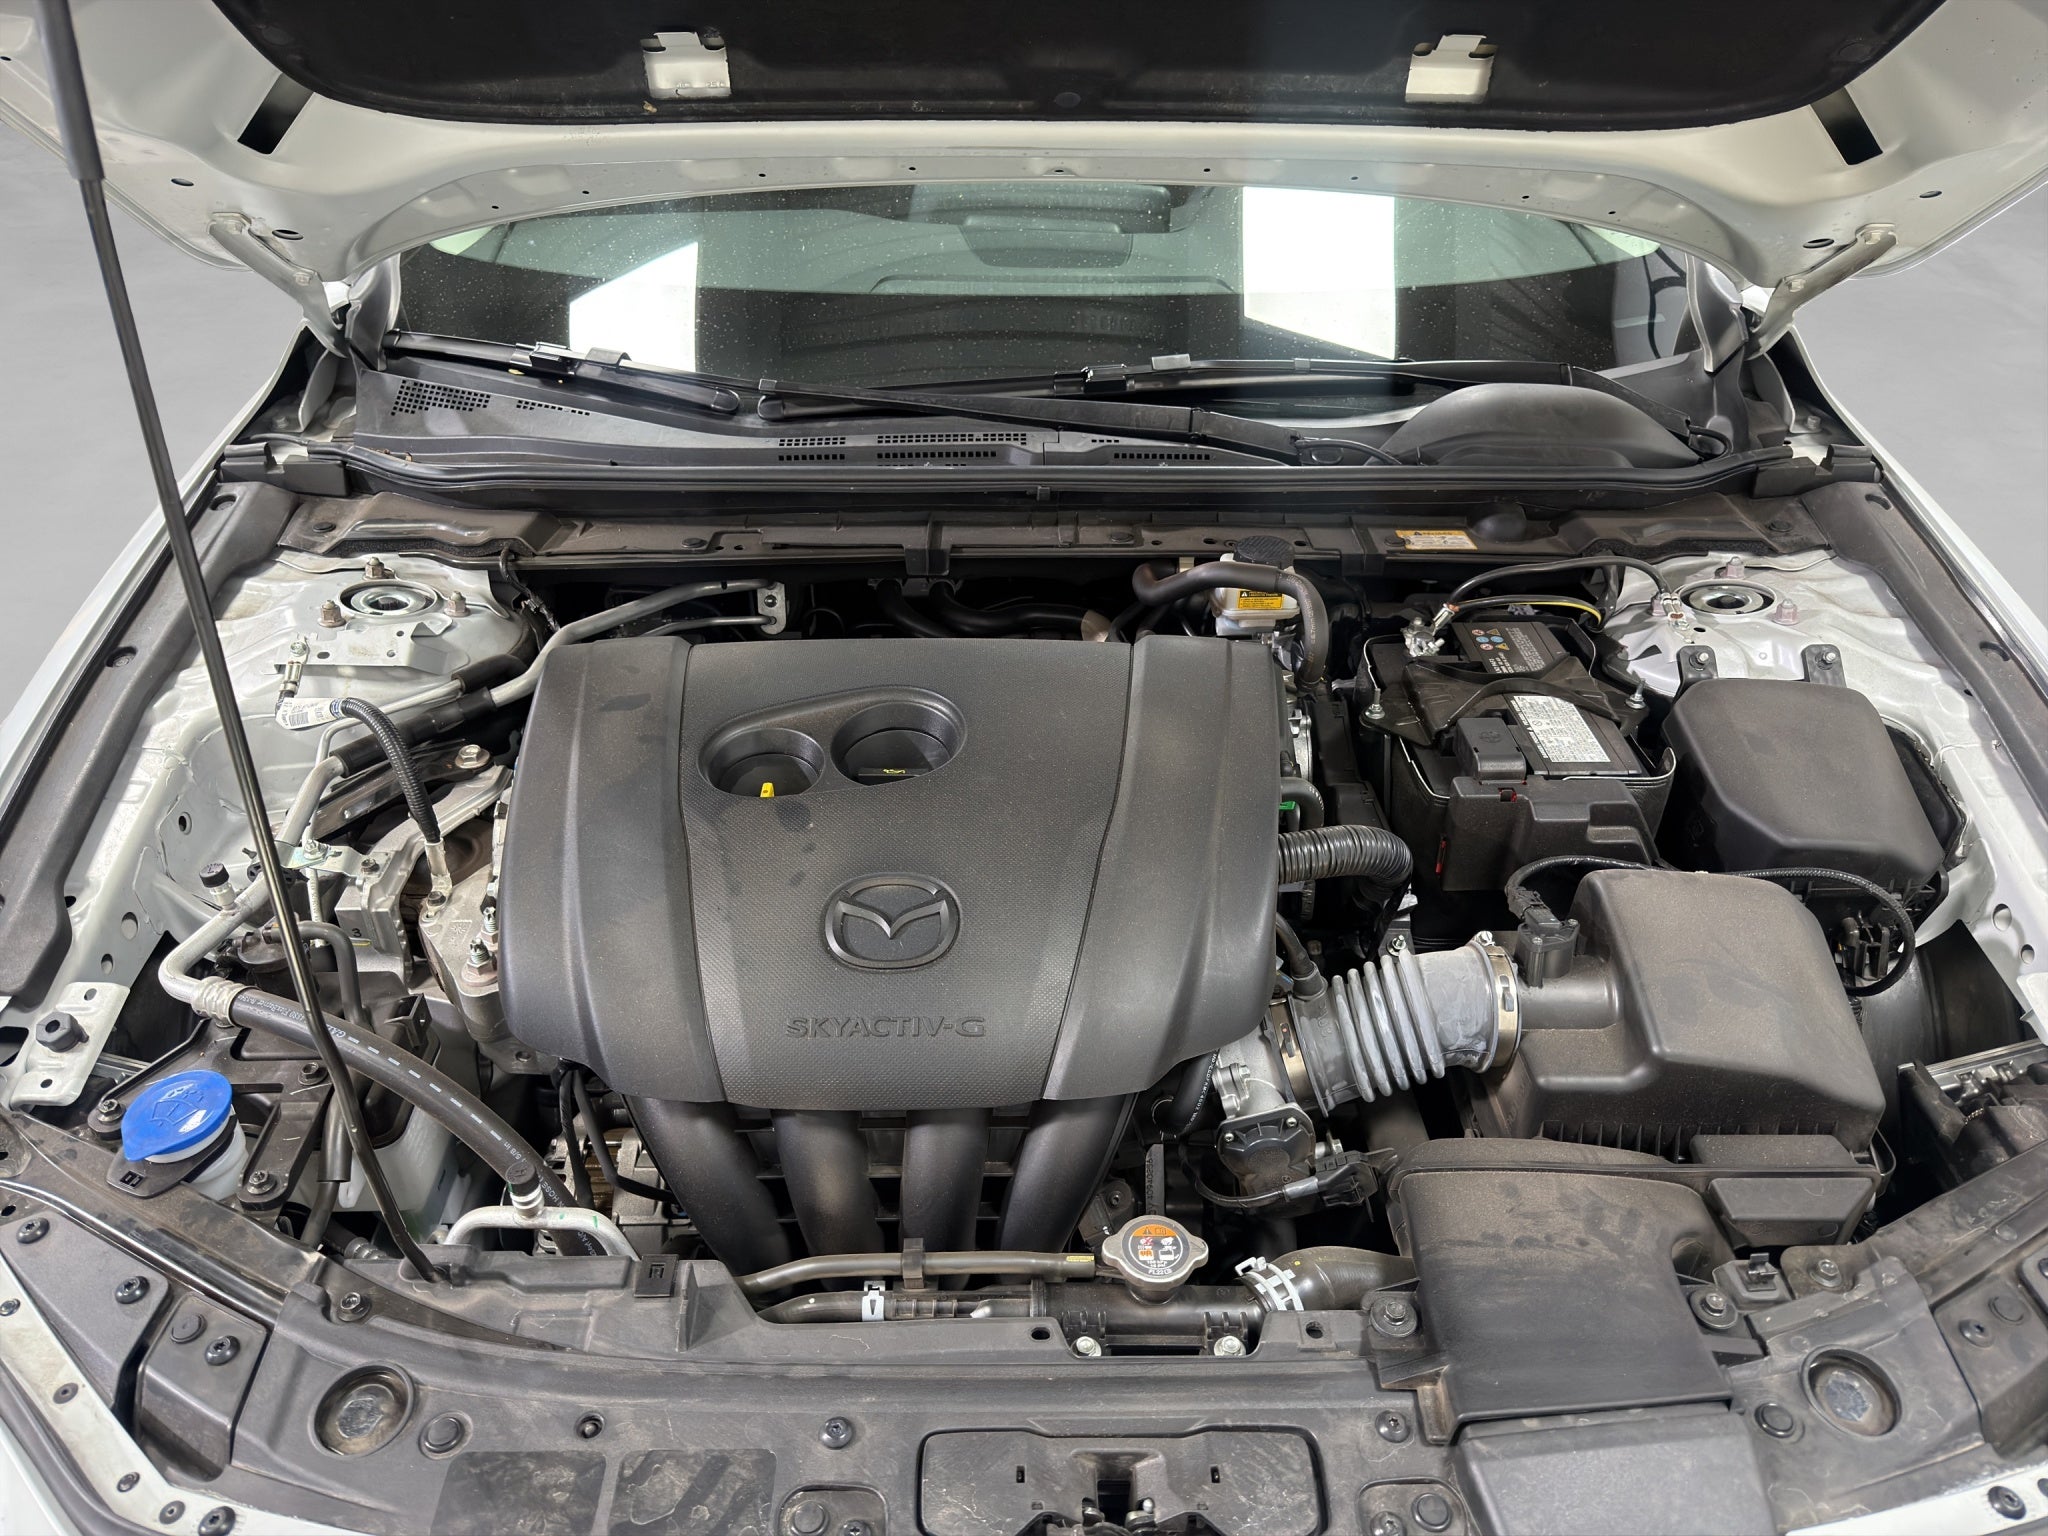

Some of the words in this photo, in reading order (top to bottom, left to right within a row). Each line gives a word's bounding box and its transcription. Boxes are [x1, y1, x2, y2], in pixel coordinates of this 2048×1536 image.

[351, 927, 362, 938] 3
[786, 1015, 986, 1038] SKYACTIV-G
[541, 1181, 560, 1203] HOSE
